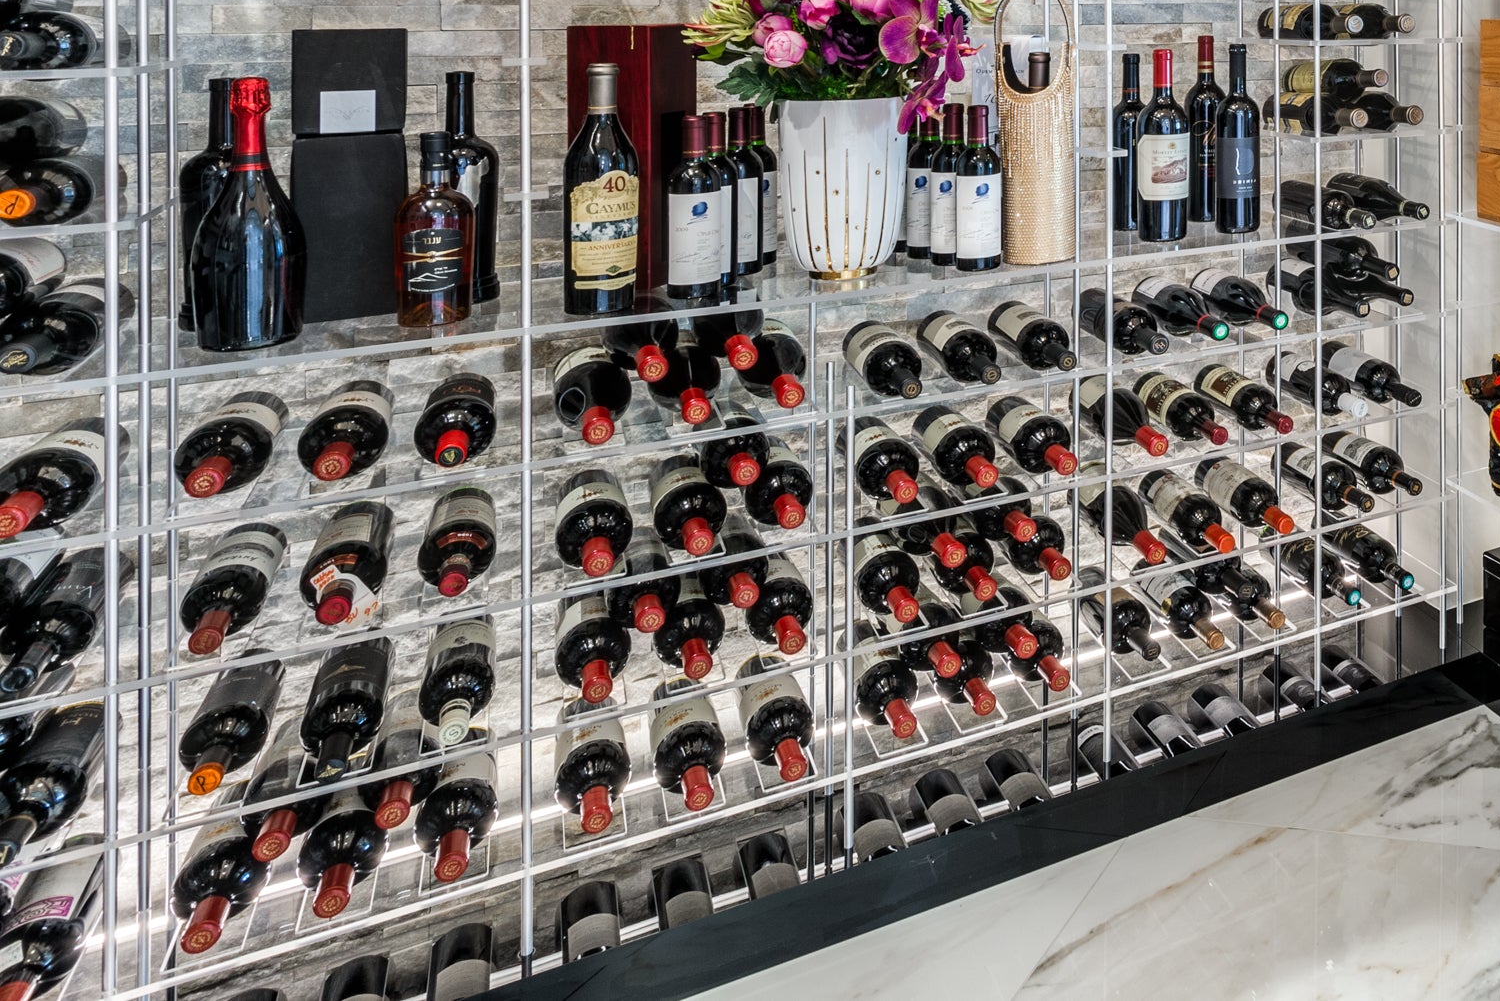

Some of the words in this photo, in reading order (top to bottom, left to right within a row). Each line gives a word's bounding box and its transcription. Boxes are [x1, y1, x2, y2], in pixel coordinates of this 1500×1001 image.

[603, 175, 627, 193] 40
[585, 200, 637, 215] CAYMUS
[422, 236, 442, 245] ענבר
